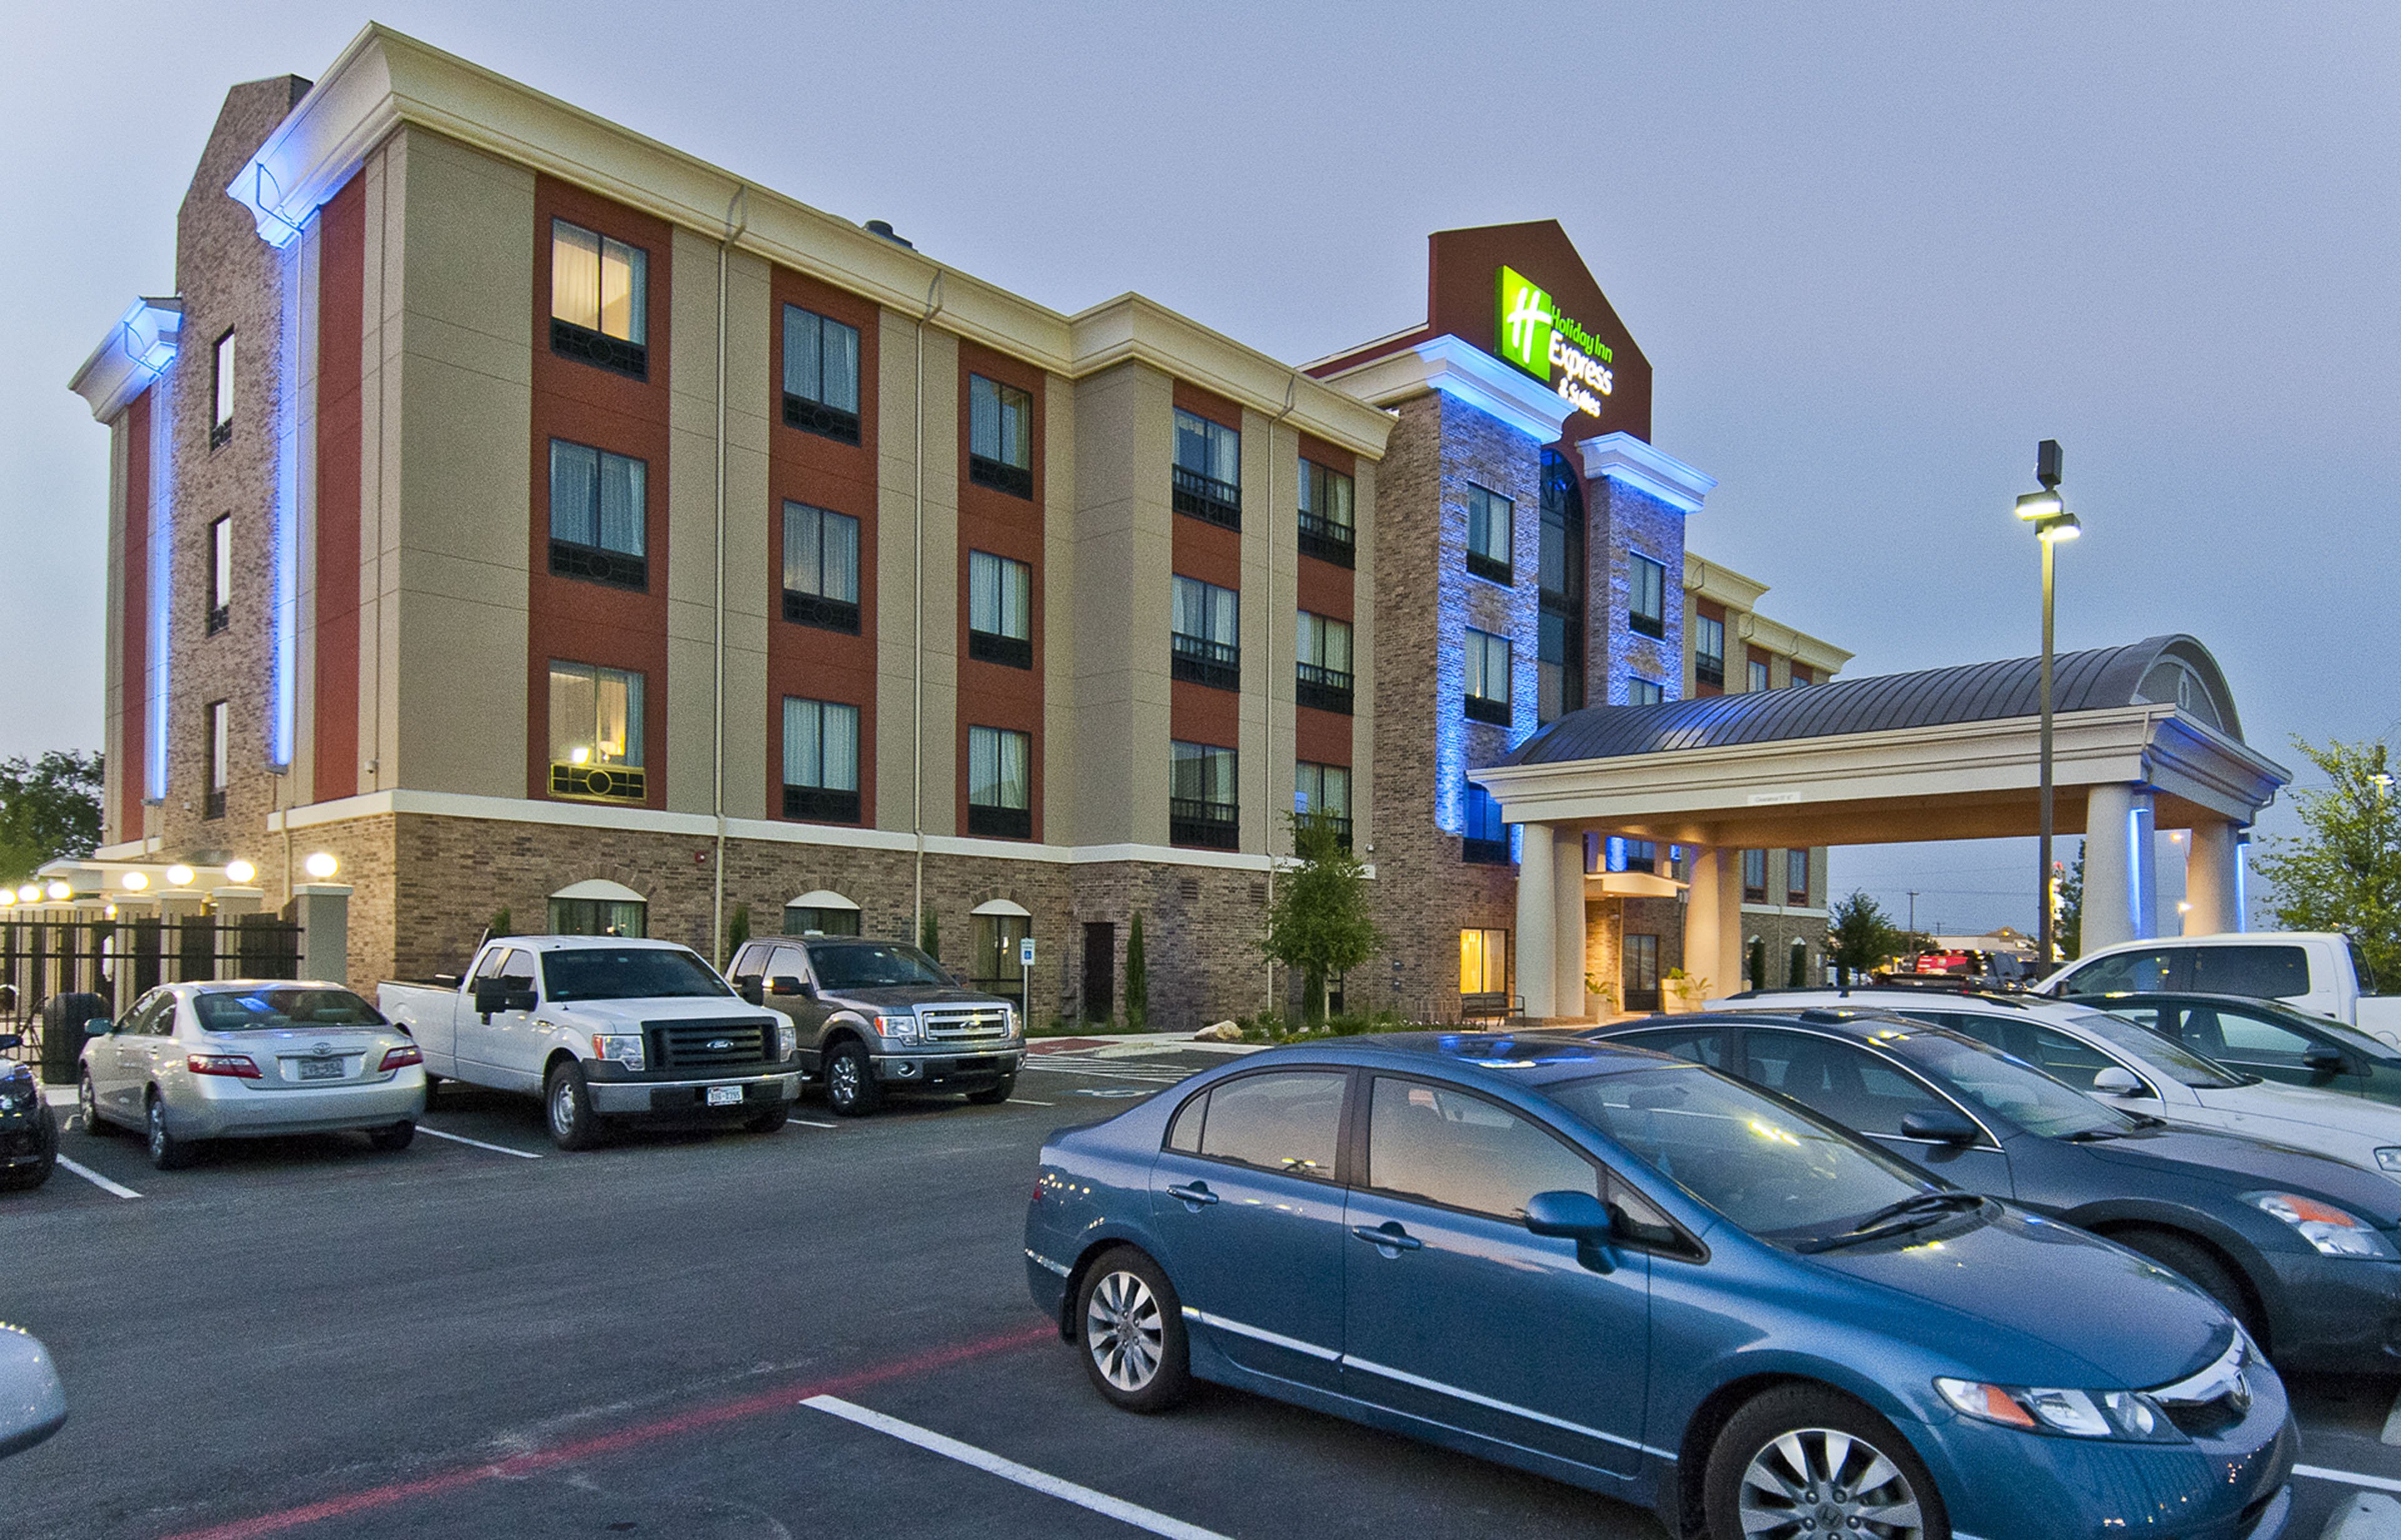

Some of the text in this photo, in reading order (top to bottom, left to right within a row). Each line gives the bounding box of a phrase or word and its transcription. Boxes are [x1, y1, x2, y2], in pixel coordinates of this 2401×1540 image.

[1548, 330, 1613, 396] Express
[1551, 304, 1613, 363] Holiday Inn
[1558, 377, 1601, 418] & Suites
